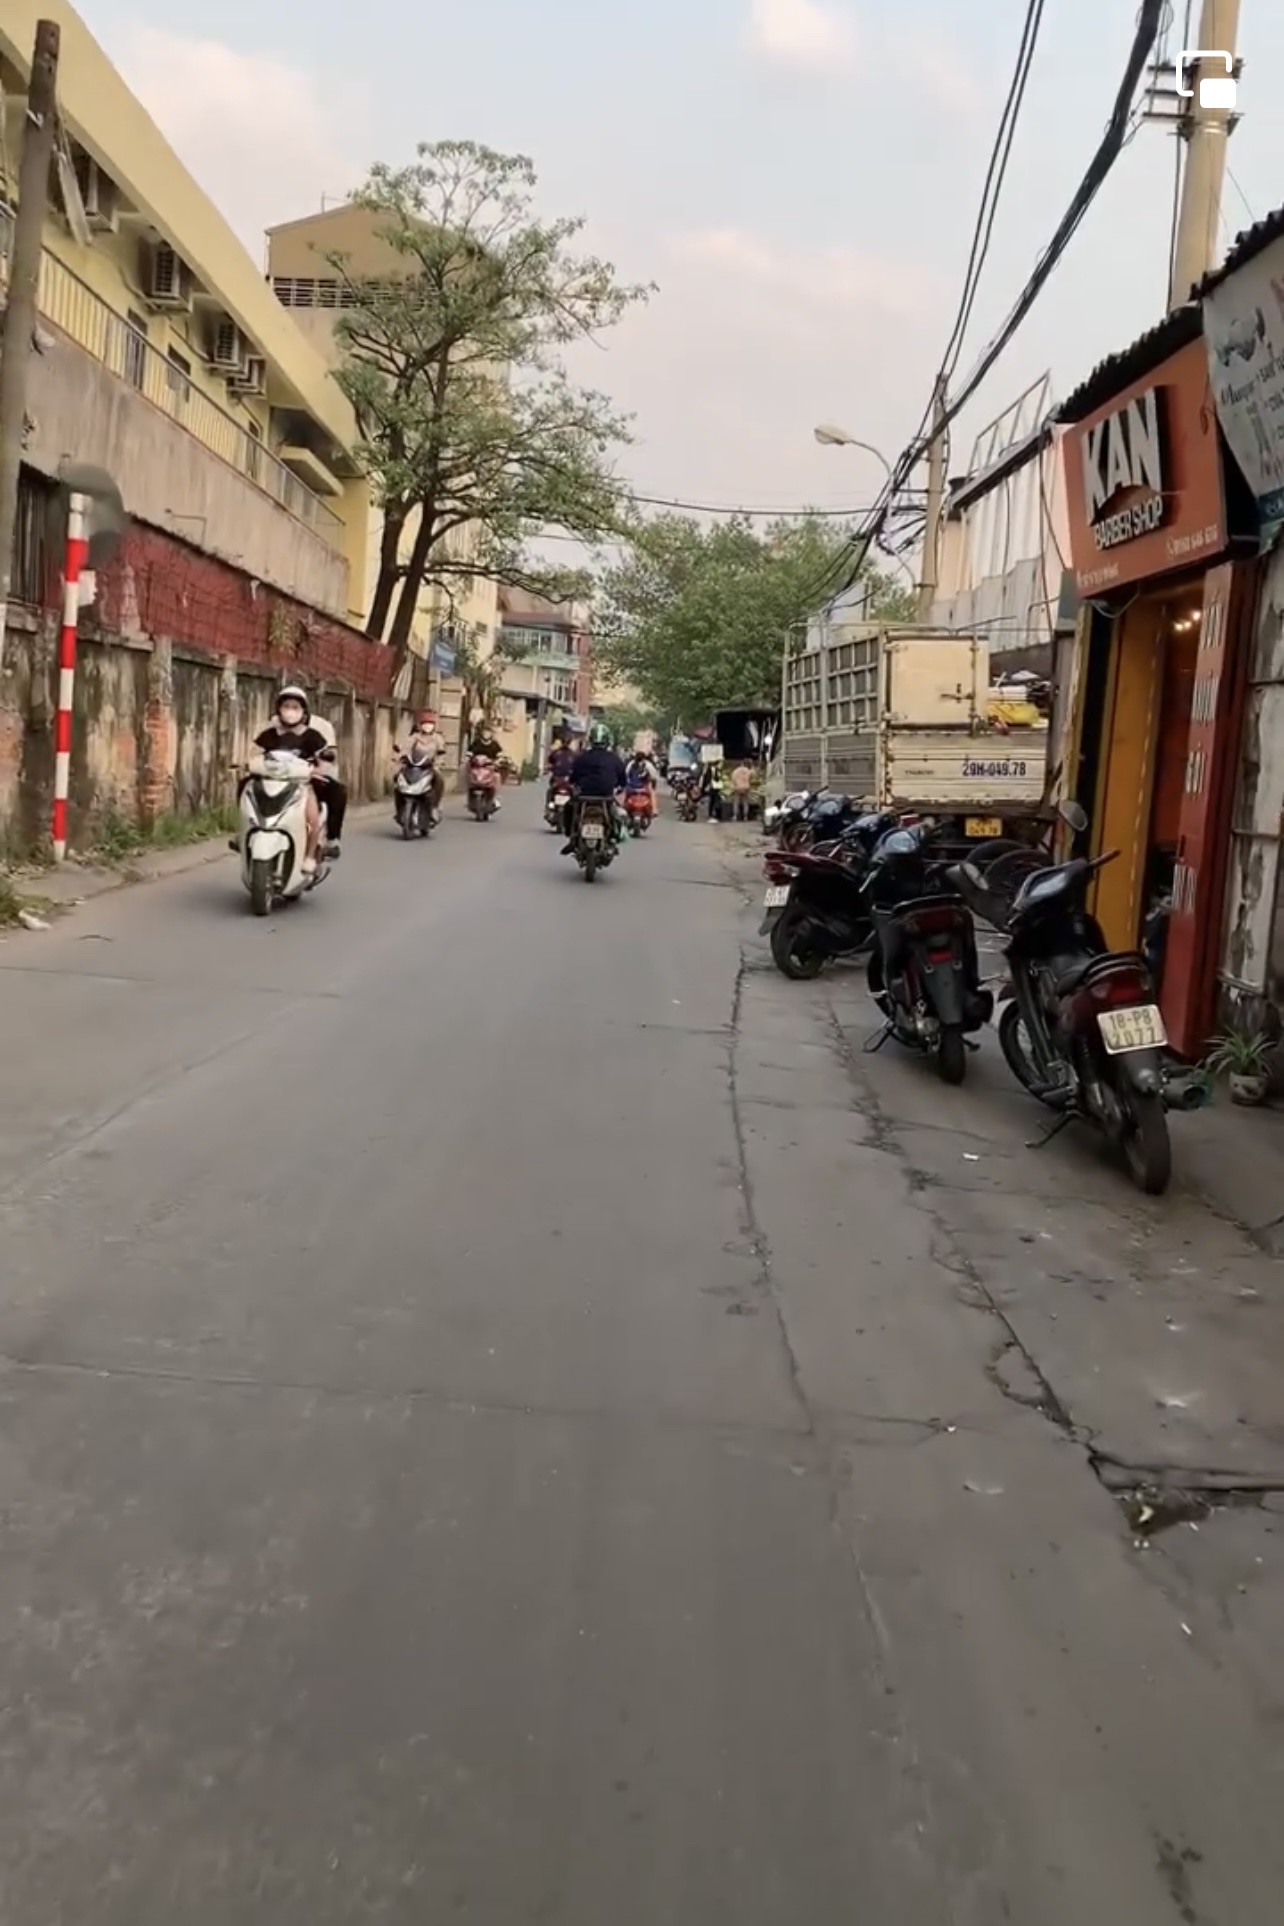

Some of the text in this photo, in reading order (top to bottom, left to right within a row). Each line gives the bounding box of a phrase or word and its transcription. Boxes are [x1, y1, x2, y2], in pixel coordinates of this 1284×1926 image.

[1082, 387, 1162, 528] KAN
[1093, 509, 1132, 550] BARBER
[1133, 495, 1163, 536] SHOP
